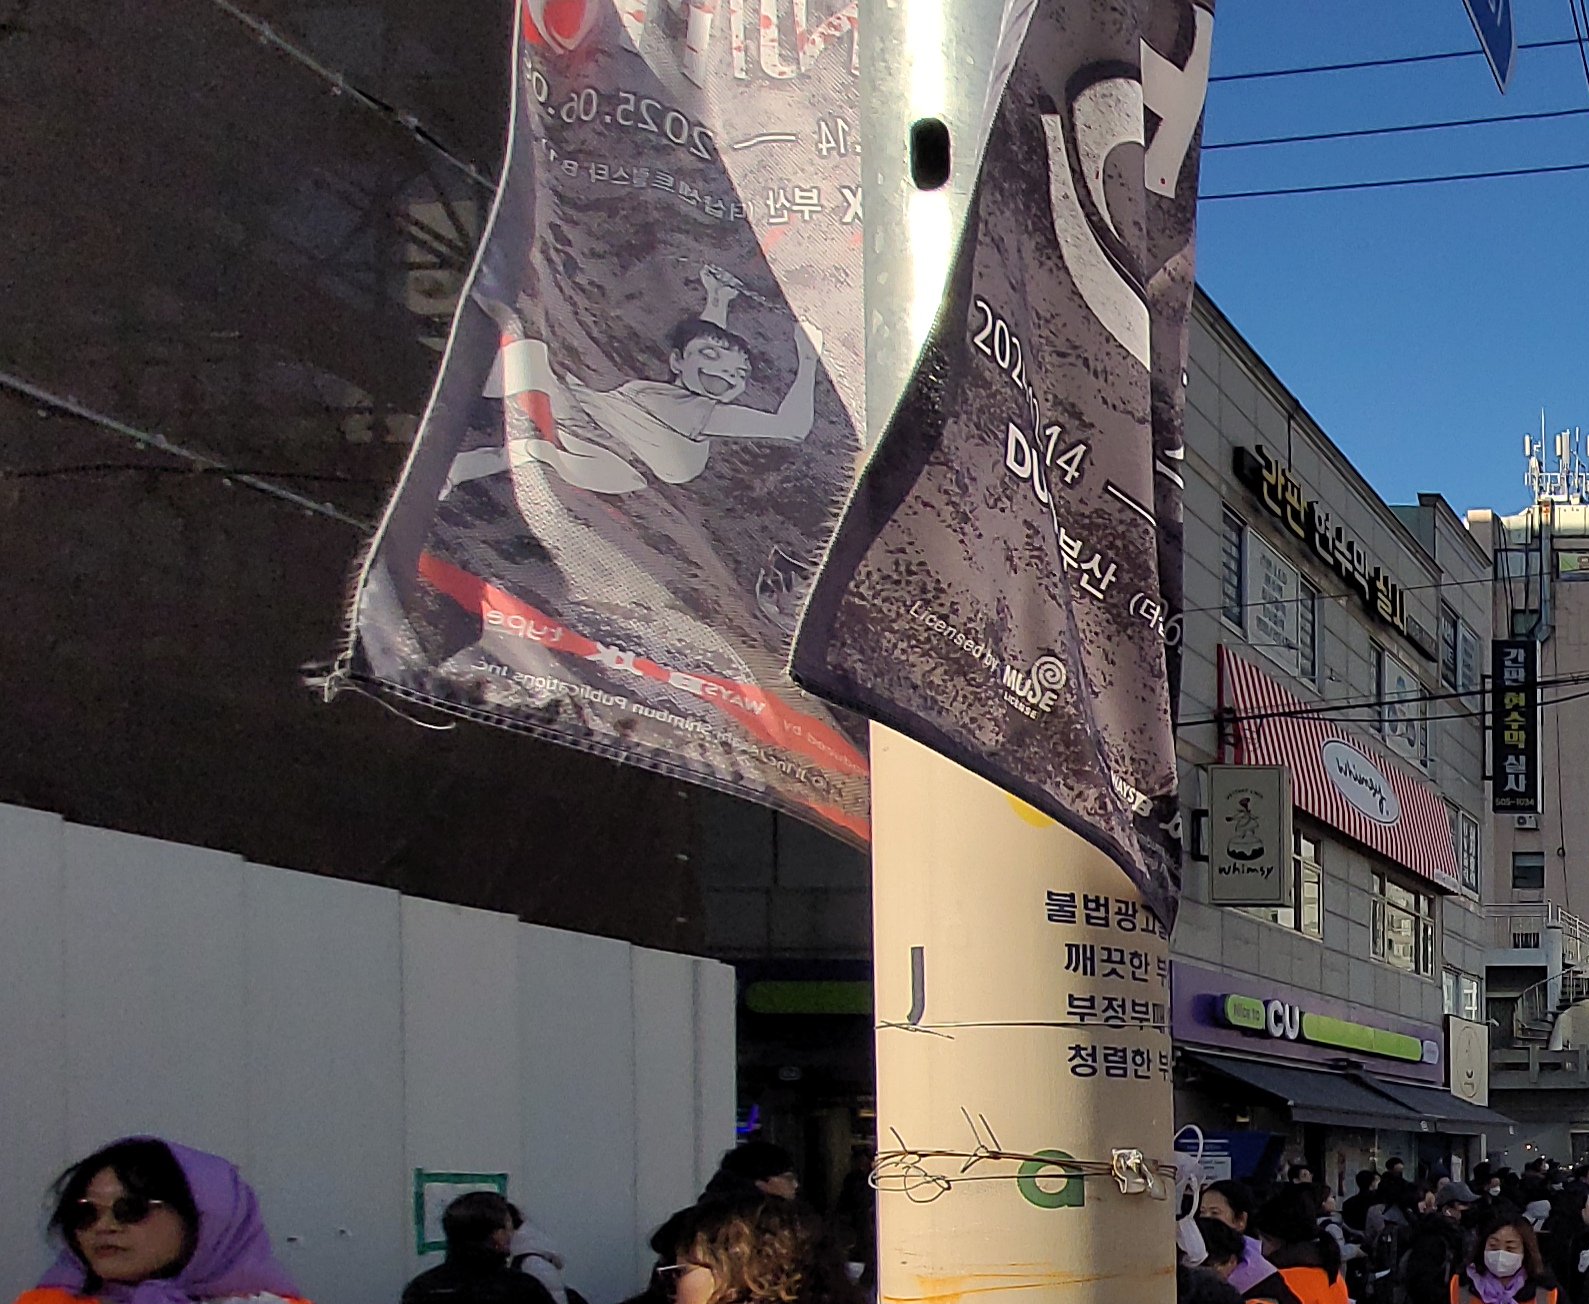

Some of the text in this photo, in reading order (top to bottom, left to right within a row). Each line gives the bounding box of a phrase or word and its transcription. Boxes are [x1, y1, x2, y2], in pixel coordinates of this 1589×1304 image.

[1058, 526, 1117, 600] 부산
[907, 600, 1001, 673] Licensed by
[1002, 655, 1067, 713] MUSE
[1503, 648, 1527, 793] 간판 현수막 실사
[1218, 862, 1275, 879] whimsy
[1064, 940, 1151, 983] 깨끗한
[1267, 999, 1300, 1041] CU
[1066, 1043, 1152, 1080] 청렴한
